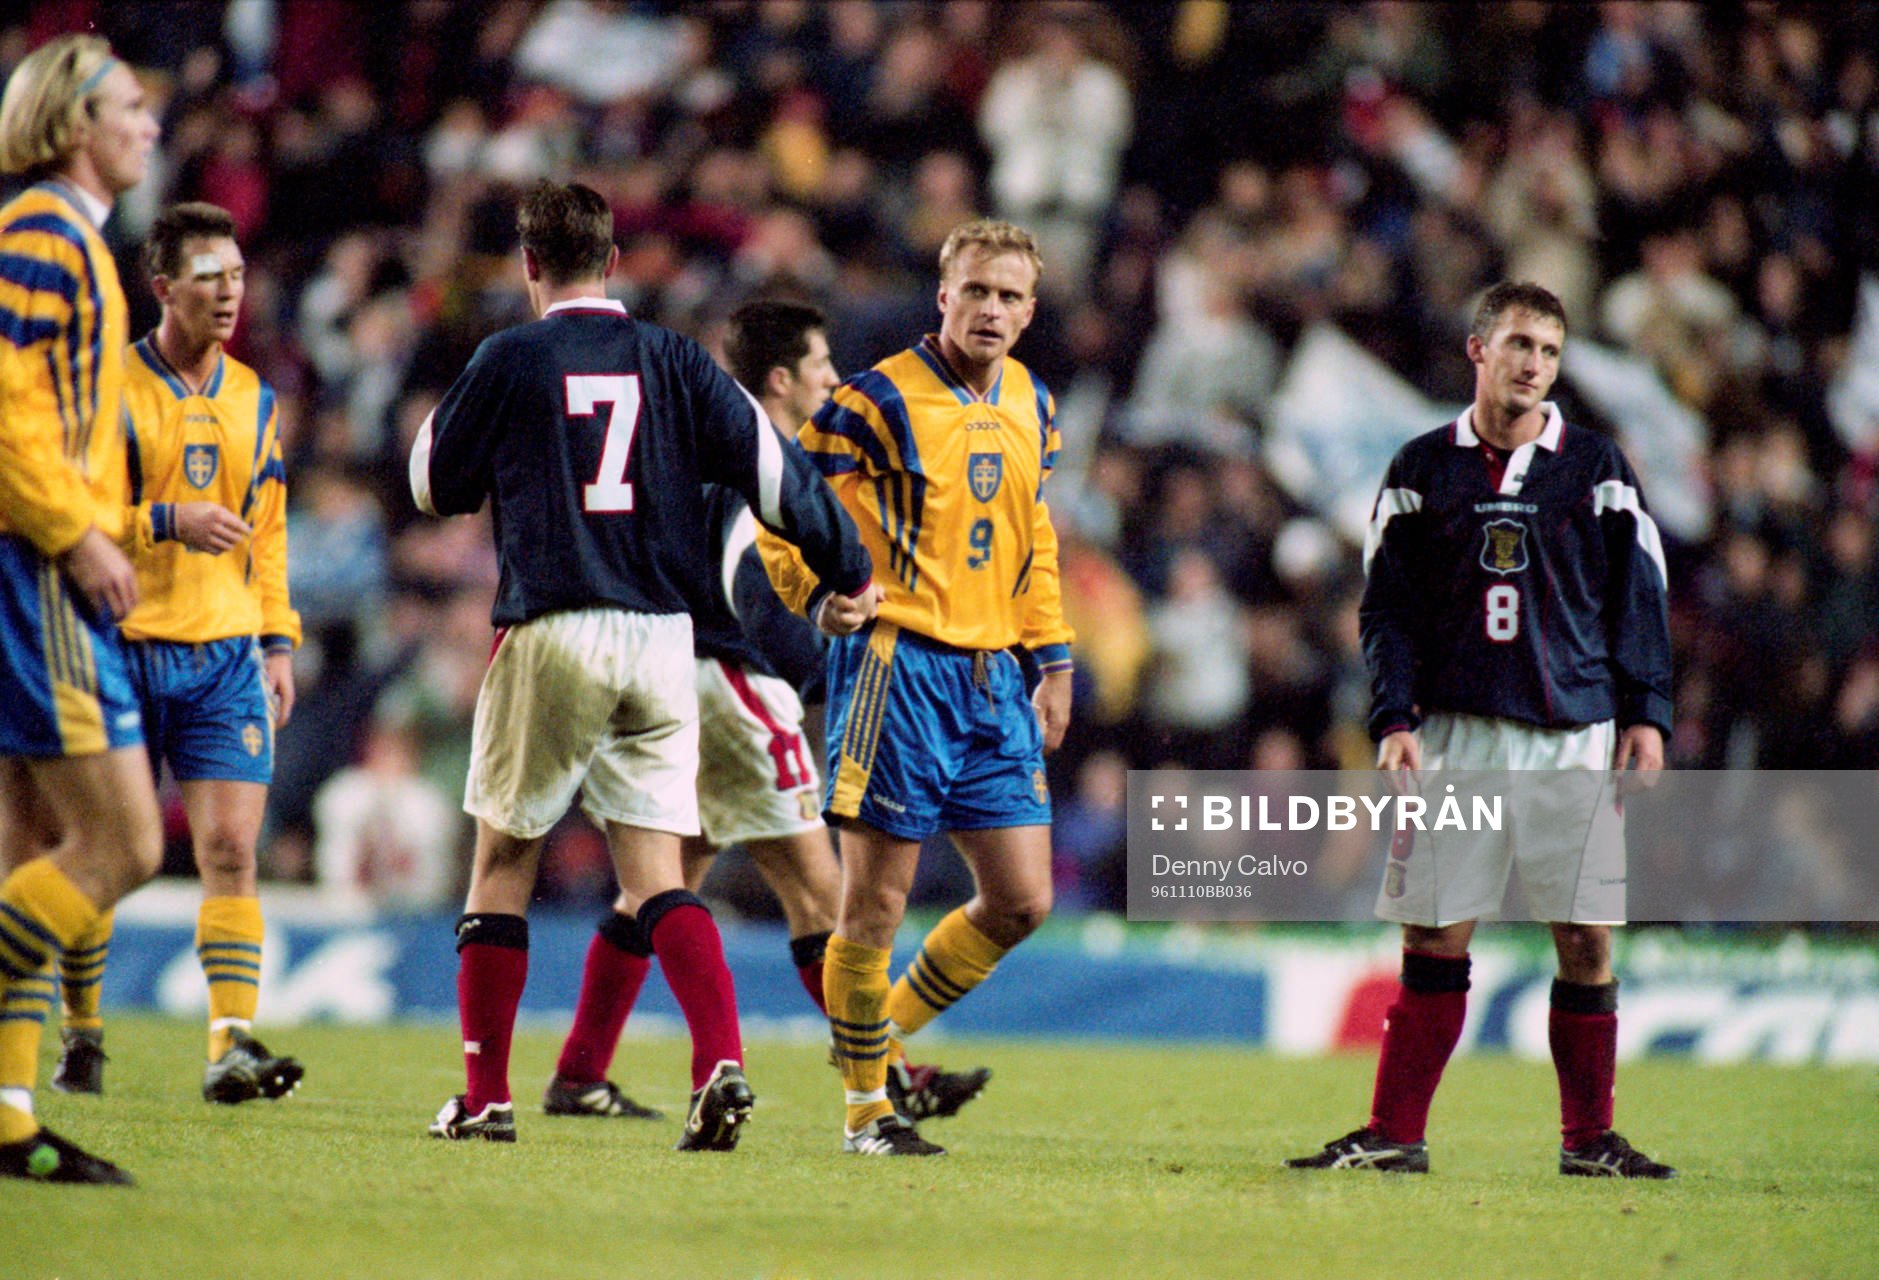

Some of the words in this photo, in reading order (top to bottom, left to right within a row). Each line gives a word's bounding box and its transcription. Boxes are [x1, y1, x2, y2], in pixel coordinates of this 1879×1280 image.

[563, 372, 642, 513] 7
[1474, 502, 1539, 513] UMBRO
[967, 517, 994, 569] 9
[1484, 583, 1520, 643] 8
